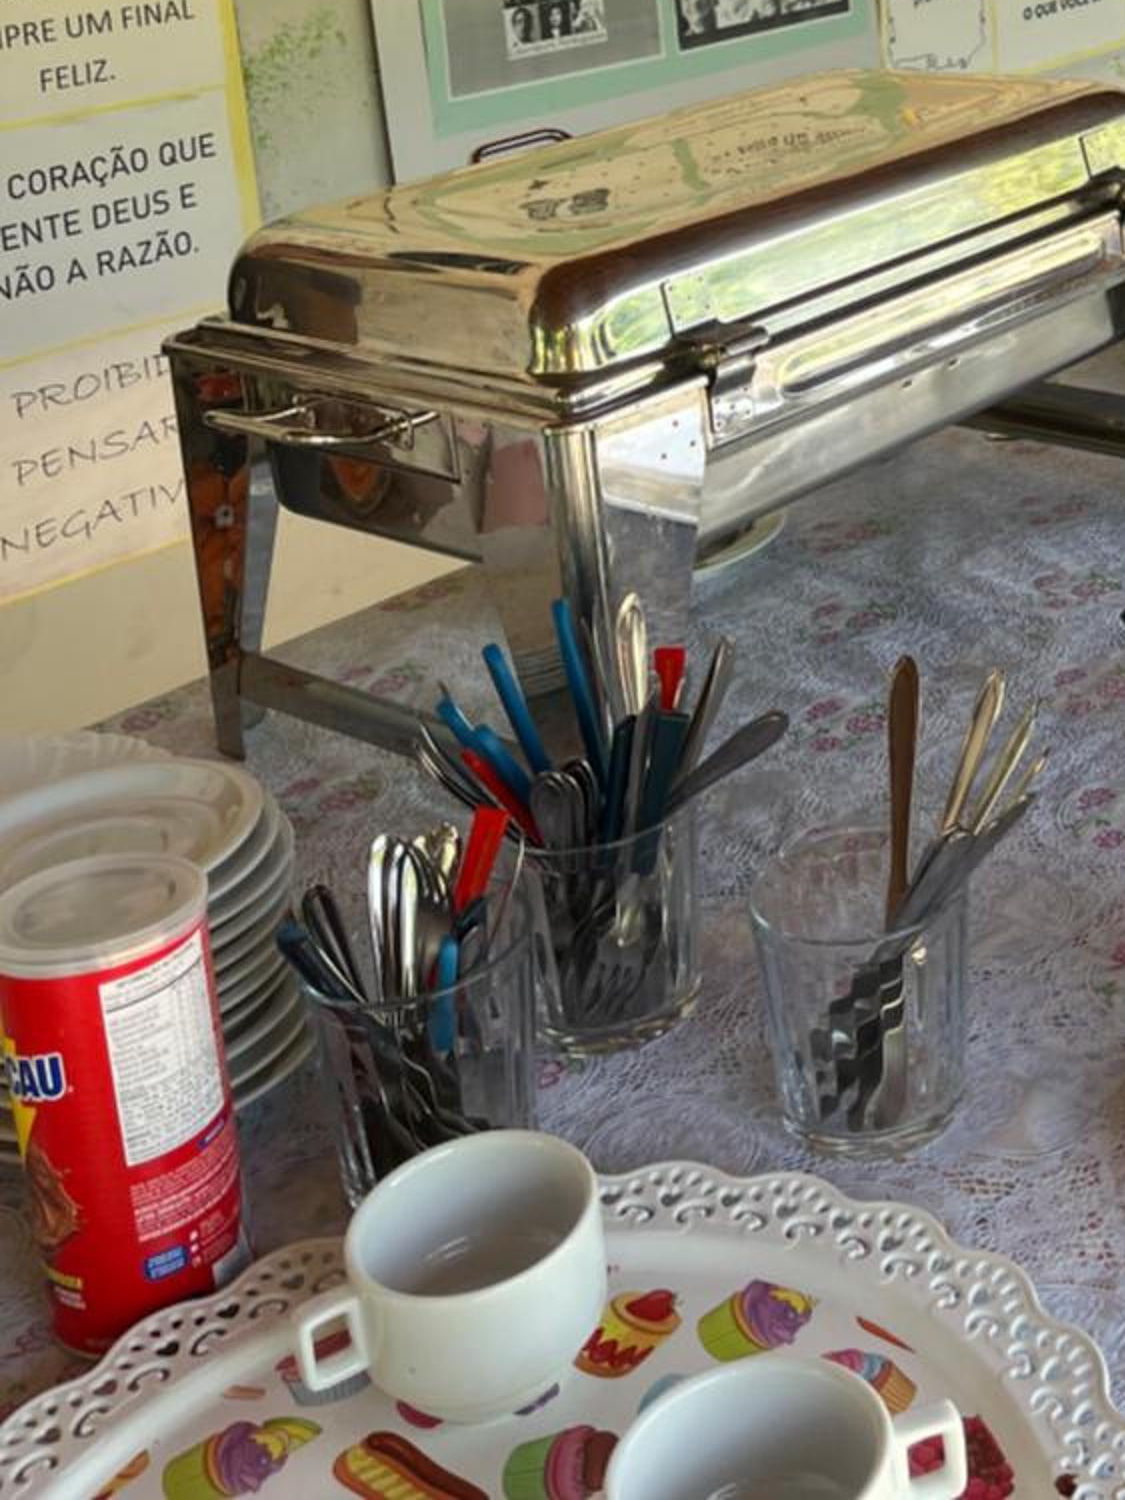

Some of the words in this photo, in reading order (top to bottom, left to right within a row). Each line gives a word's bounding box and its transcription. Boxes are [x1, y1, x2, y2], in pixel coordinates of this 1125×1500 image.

[0, 17, 57, 50] PRE
[65, 9, 113, 40] UM
[39, 59, 117, 93] FELIZ.
[7, 145, 149, 201] CORAÇÃO
[158, 132, 217, 167] QUE
[0, 208, 82, 253] ENTE
[92, 190, 170, 231] DEUS
[179, 182, 197, 210] E
[66, 258, 88, 285] A
[96, 230, 200, 277] RAZÃO.
